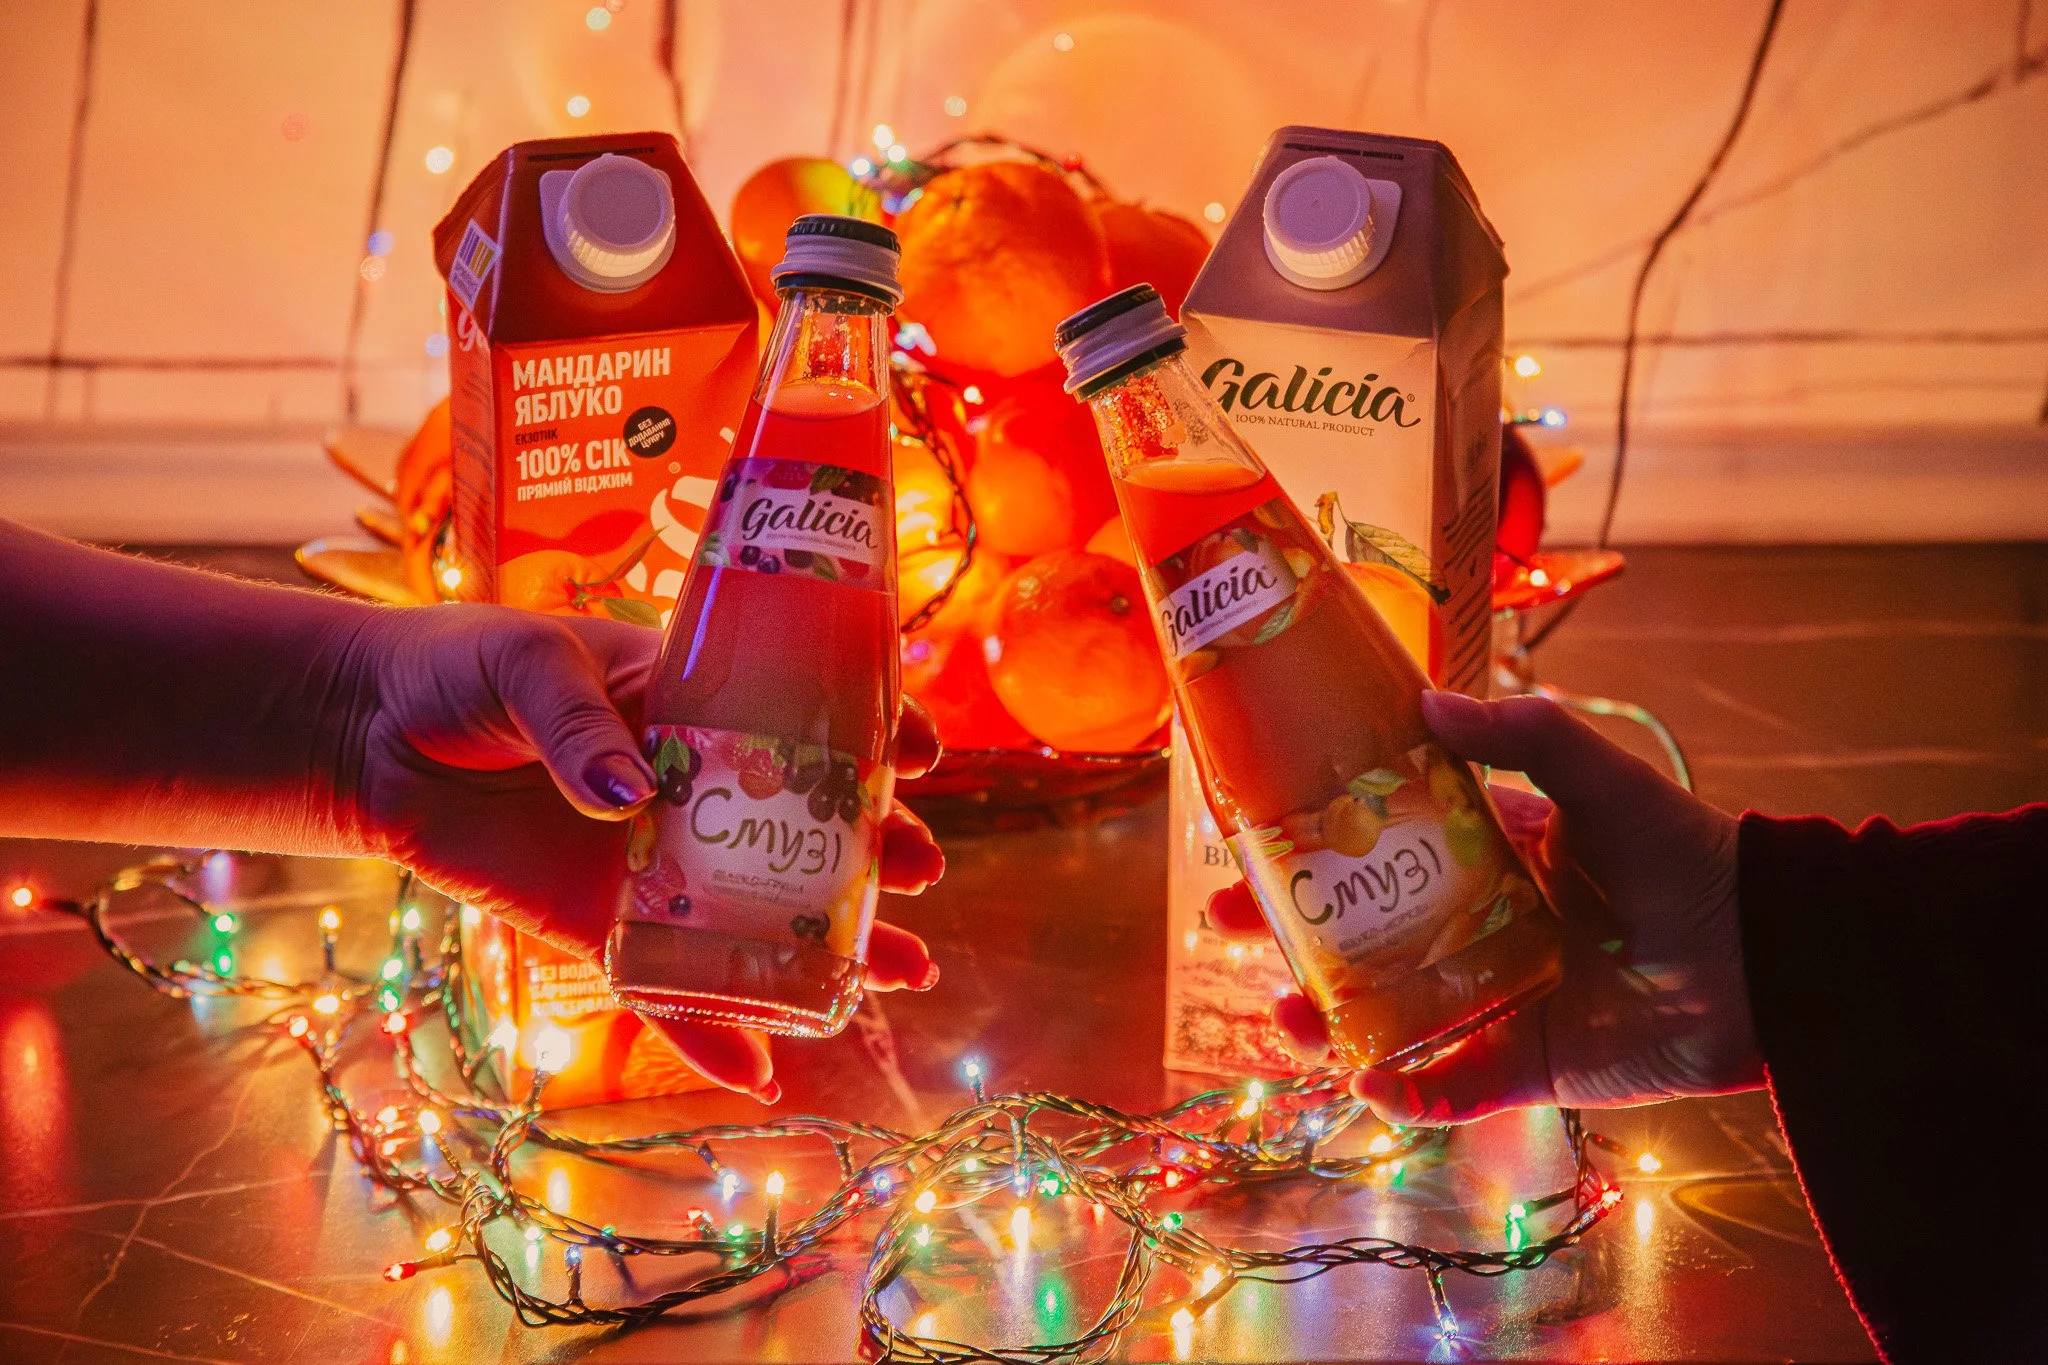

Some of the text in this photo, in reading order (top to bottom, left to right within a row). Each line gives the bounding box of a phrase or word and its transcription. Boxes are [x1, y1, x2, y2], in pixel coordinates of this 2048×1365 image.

[512, 348, 670, 391] МАНДАРИН
[515, 385, 622, 427] ЯБЛУКО
[515, 428, 558, 446] ЕКЗОТИК
[637, 418, 653, 431] БЕЗ
[640, 430, 665, 448] ЦУКРУ
[1235, 413, 1375, 437] 100% NATURAL PRODUCT
[516, 438, 631, 480] 100% СІК
[517, 471, 633, 501] ПРЯМИЙ ВІДЖИМ
[742, 498, 877, 549] Galicia
